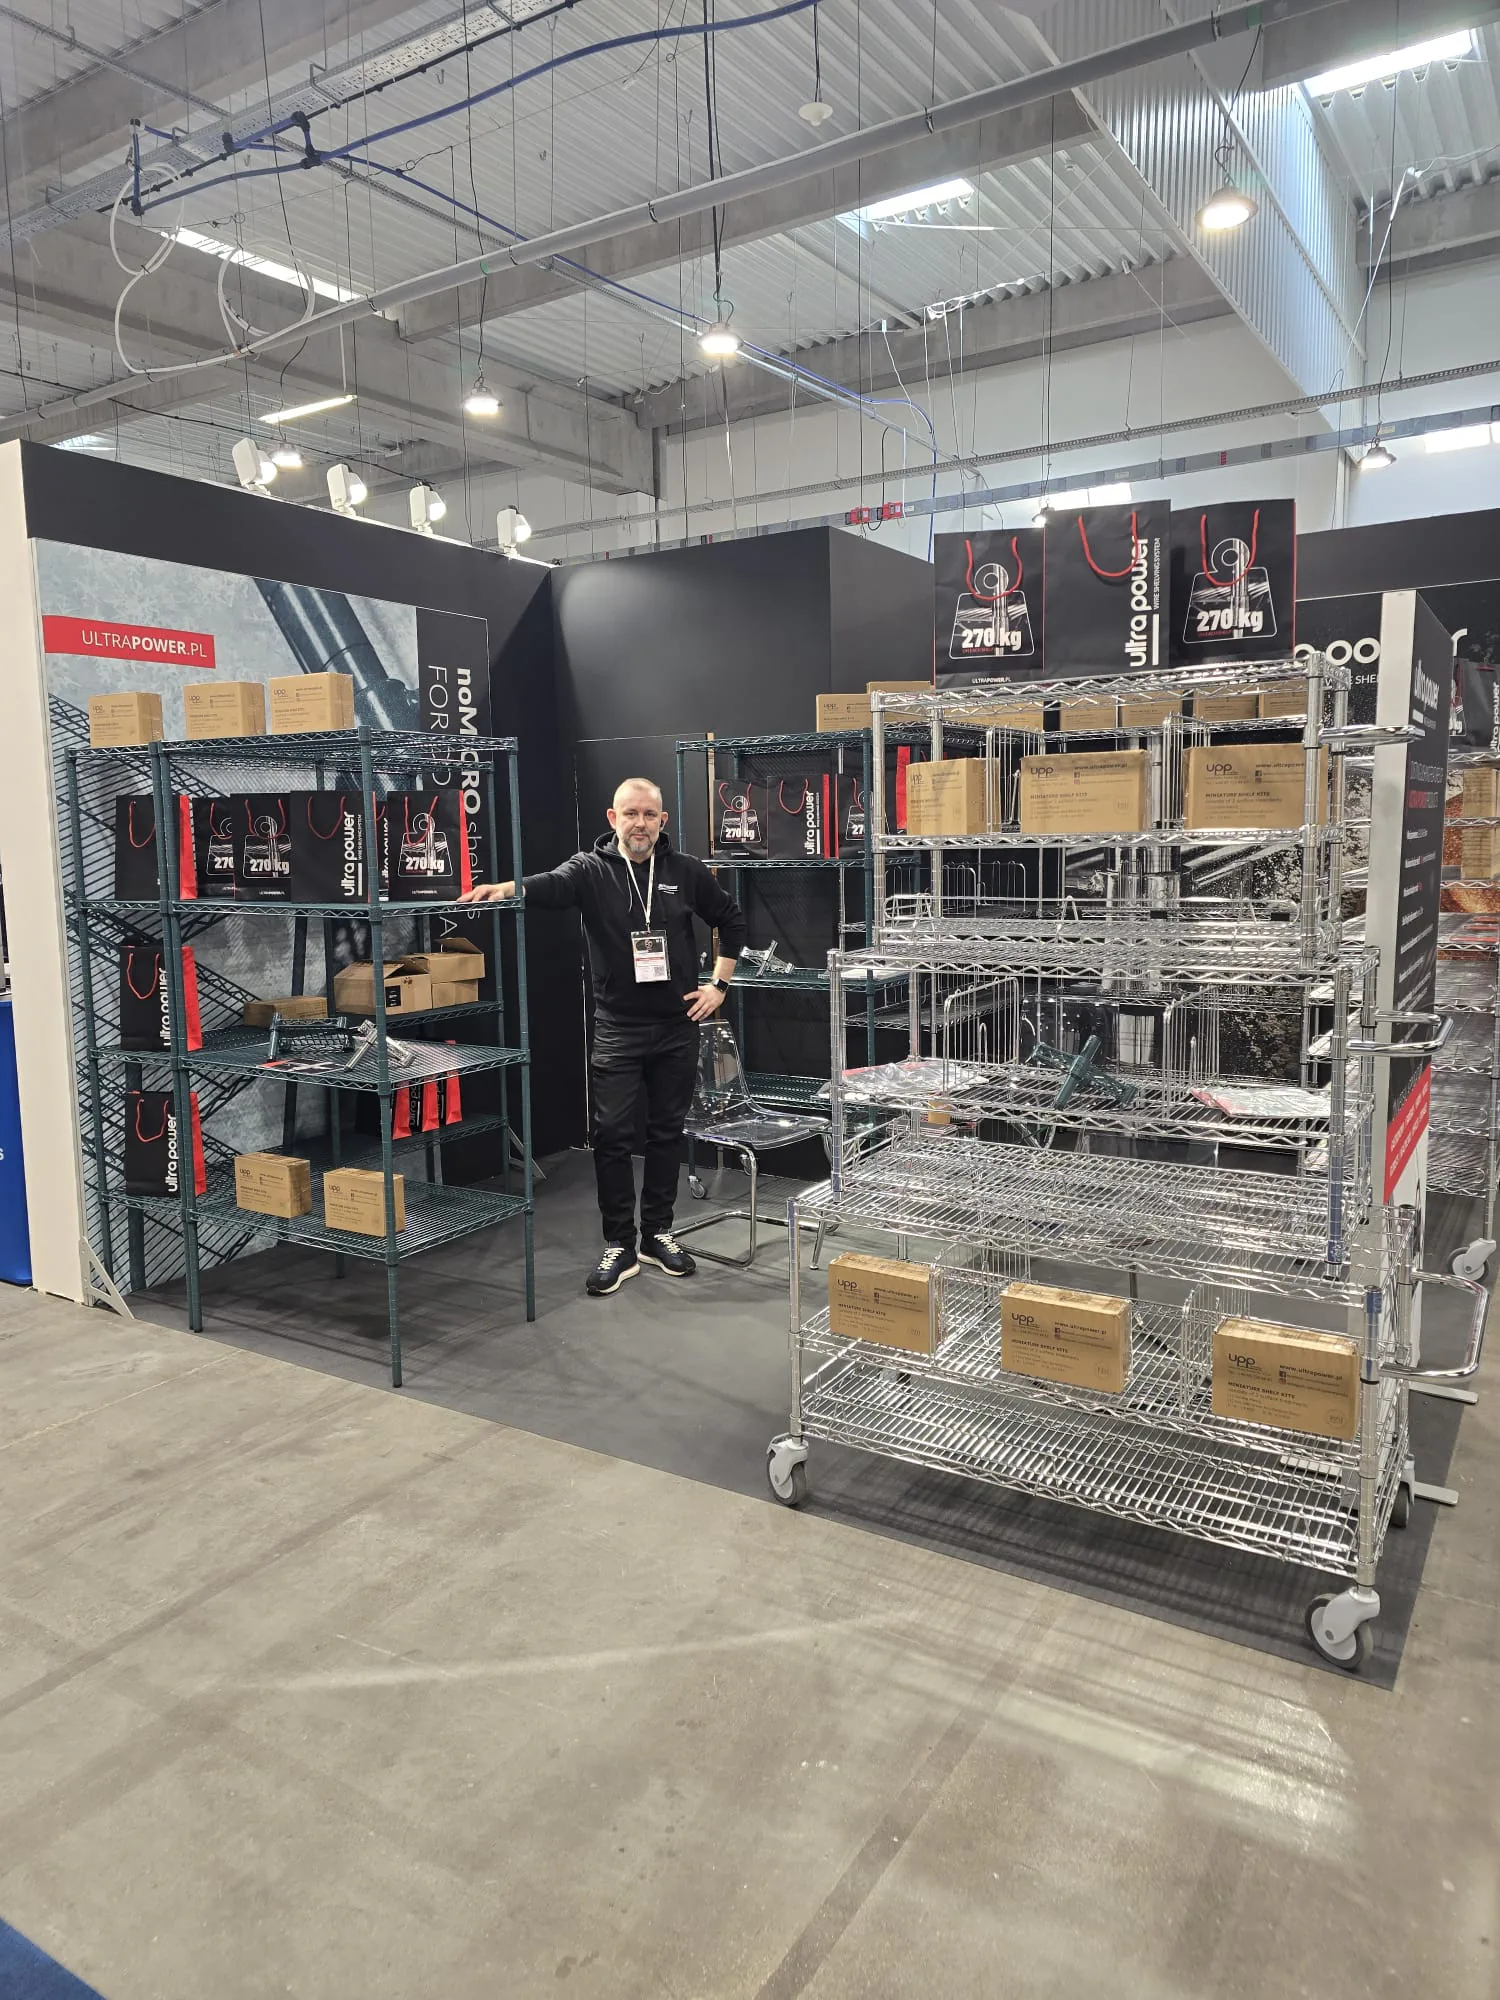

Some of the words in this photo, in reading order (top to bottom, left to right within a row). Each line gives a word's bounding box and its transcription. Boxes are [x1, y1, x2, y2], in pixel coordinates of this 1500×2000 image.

[1131, 536, 1152, 611] power
[1196, 608, 1234, 632] 270
[1238, 607, 1263, 633] kg
[82, 629, 208, 658] ULTRAPOWER.PL
[961, 627, 996, 649] 270
[999, 627, 1022, 651] kg
[1125, 614, 1147, 667] ultra
[1355, 673, 1378, 685] SHE
[428, 665, 449, 730] FOR
[456, 667, 481, 816] noMCRO
[1030, 766, 1054, 778] upp
[1206, 763, 1233, 776] upp
[805, 791, 816, 828] power
[344, 811, 357, 861] power
[725, 827, 741, 838] 270
[743, 827, 755, 840] kg
[851, 824, 864, 835] 27
[804, 830, 815, 855] ultra
[250, 858, 271, 871] 270
[273, 860, 290, 875] kg
[405, 857, 427, 870] 270
[430, 857, 445, 872] kg
[341, 863, 355, 896] ultra
[167, 1114, 180, 1160] power
[165, 1161, 178, 1192] ultra
[837, 1279, 858, 1292] upp
[1011, 1312, 1035, 1326] upp
[1228, 1353, 1256, 1369] upp
[1279, 1364, 1343, 1380] www.ultrapower.pl
